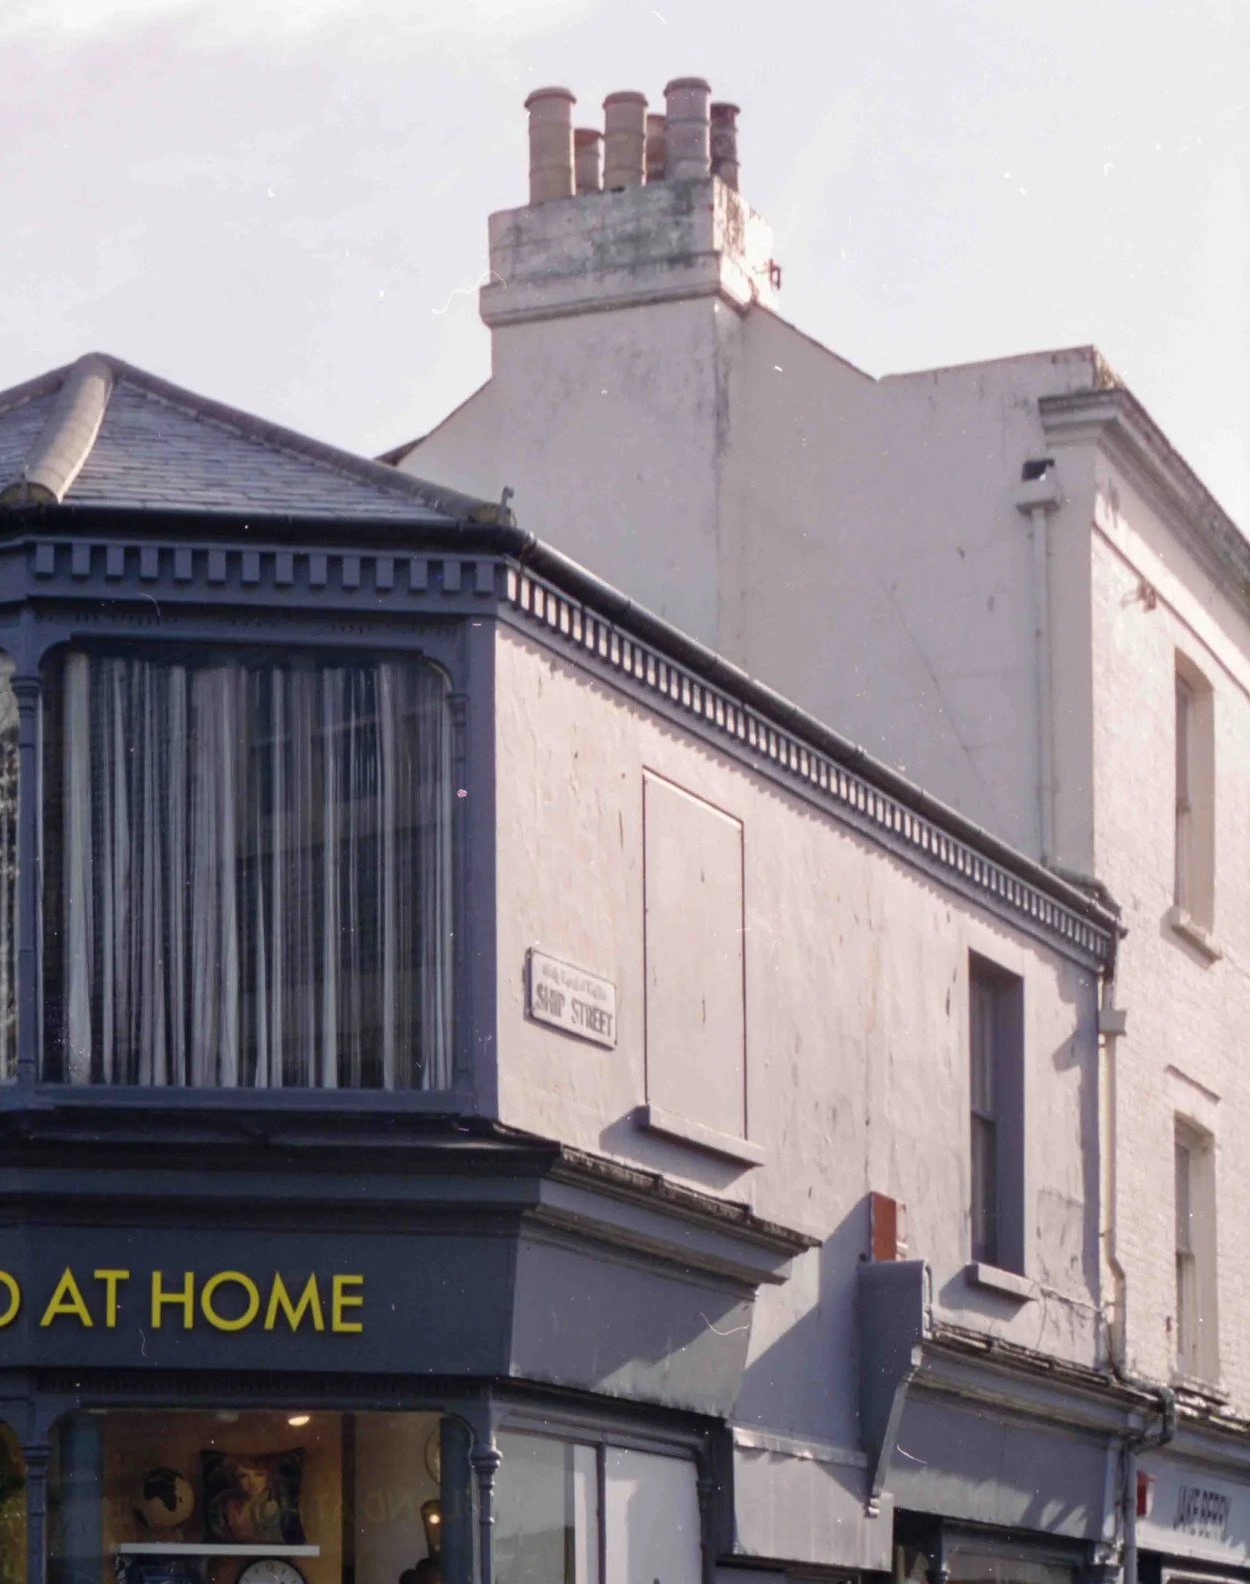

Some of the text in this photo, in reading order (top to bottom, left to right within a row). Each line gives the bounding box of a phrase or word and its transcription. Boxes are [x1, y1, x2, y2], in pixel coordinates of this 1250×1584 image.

[536, 982, 566, 1018] SHIP
[571, 997, 613, 1038] STREET
[39, 1266, 130, 1327] AT
[151, 1271, 364, 1333] HOME
